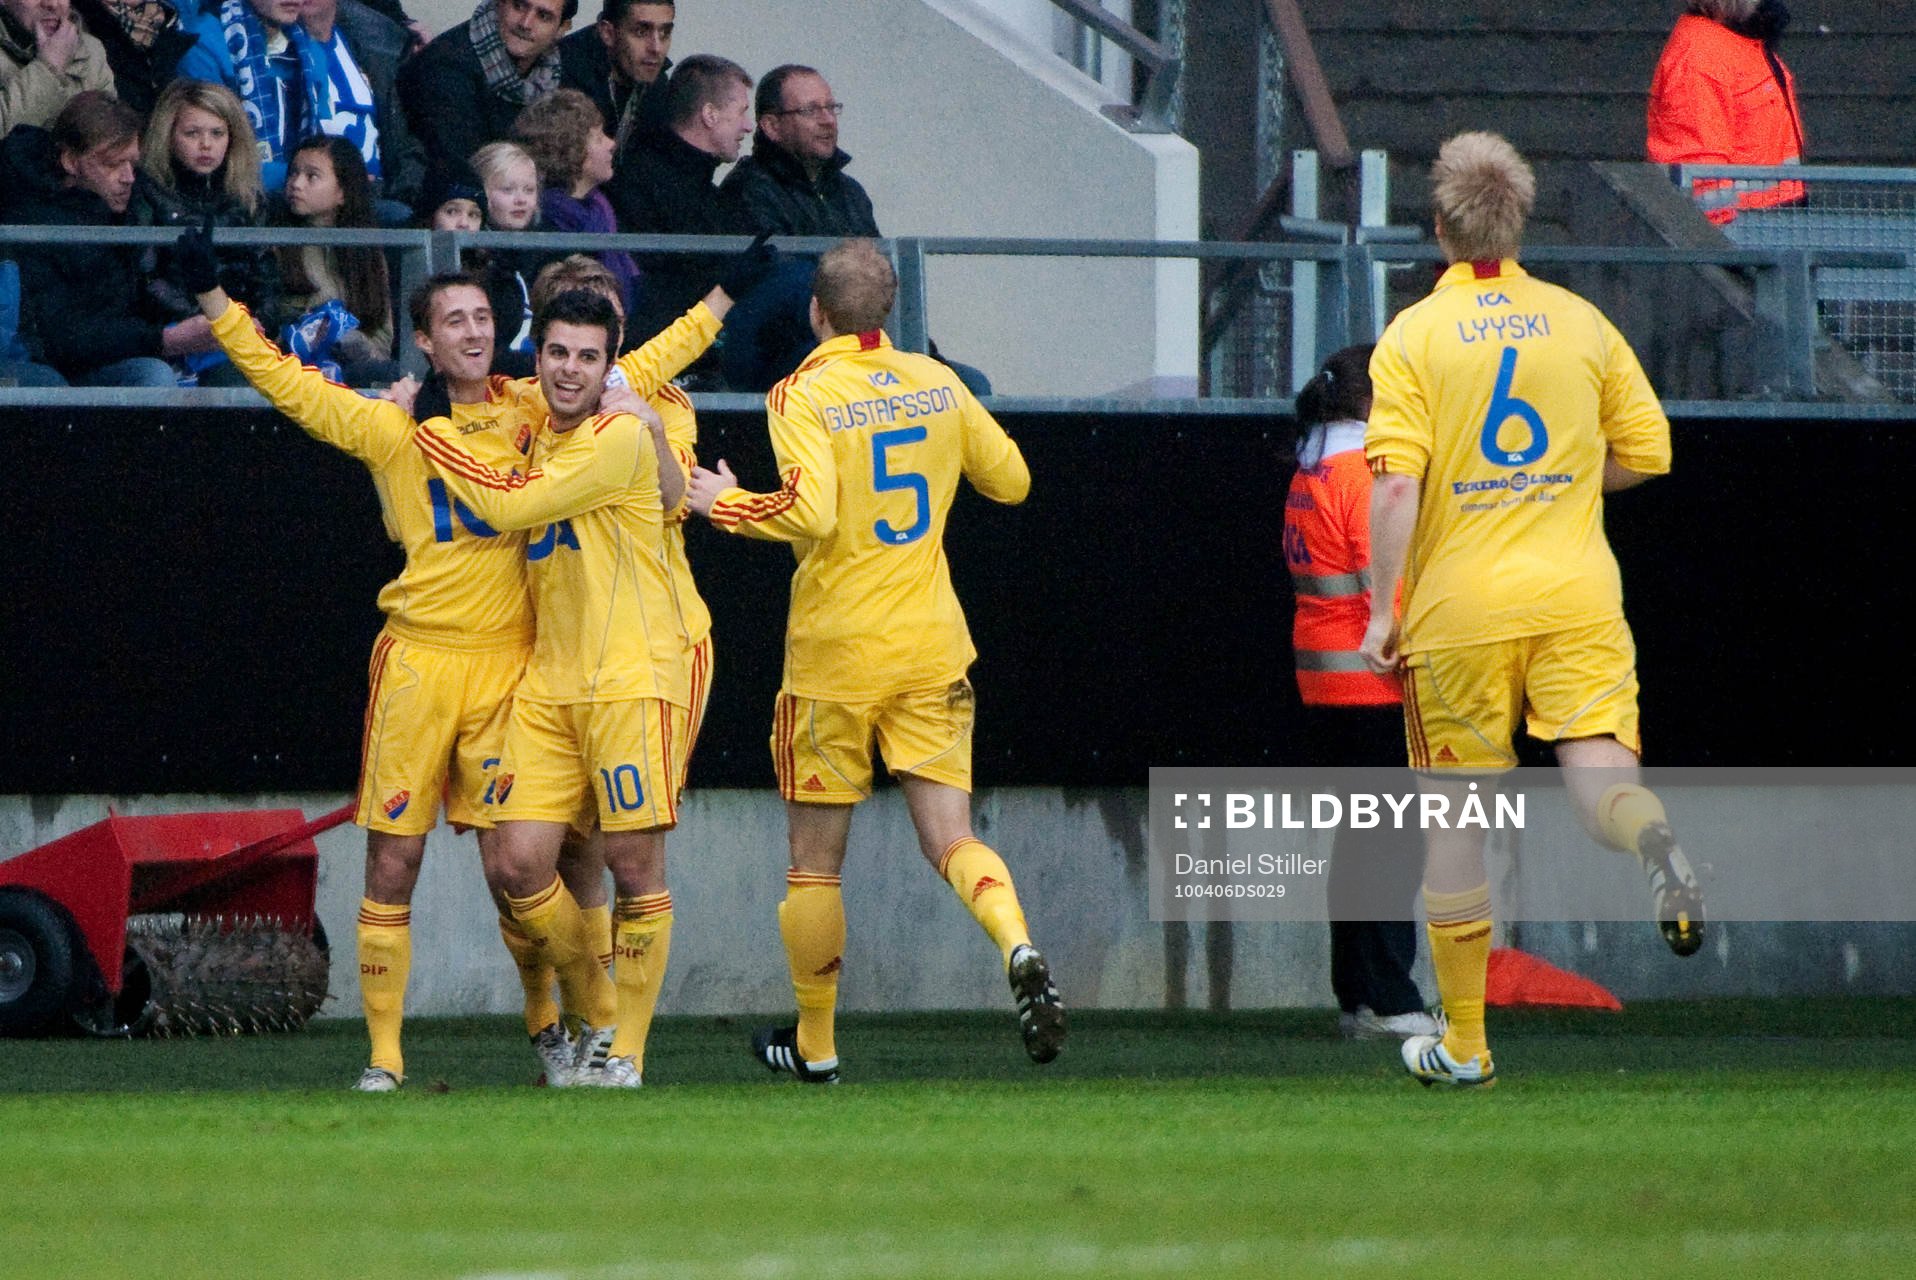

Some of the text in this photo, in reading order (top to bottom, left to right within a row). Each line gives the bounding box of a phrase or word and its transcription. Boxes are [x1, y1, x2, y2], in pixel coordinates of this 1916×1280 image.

[1477, 292, 1512, 307] ICA
[1457, 313, 1551, 344] LYYSKI
[868, 371, 901, 387] ICA
[825, 386, 959, 432] GUSTAFSSON
[1480, 346, 1549, 467] 6
[871, 425, 931, 546] 5
[600, 763, 645, 814] 10
[360, 963, 388, 976] DIF
